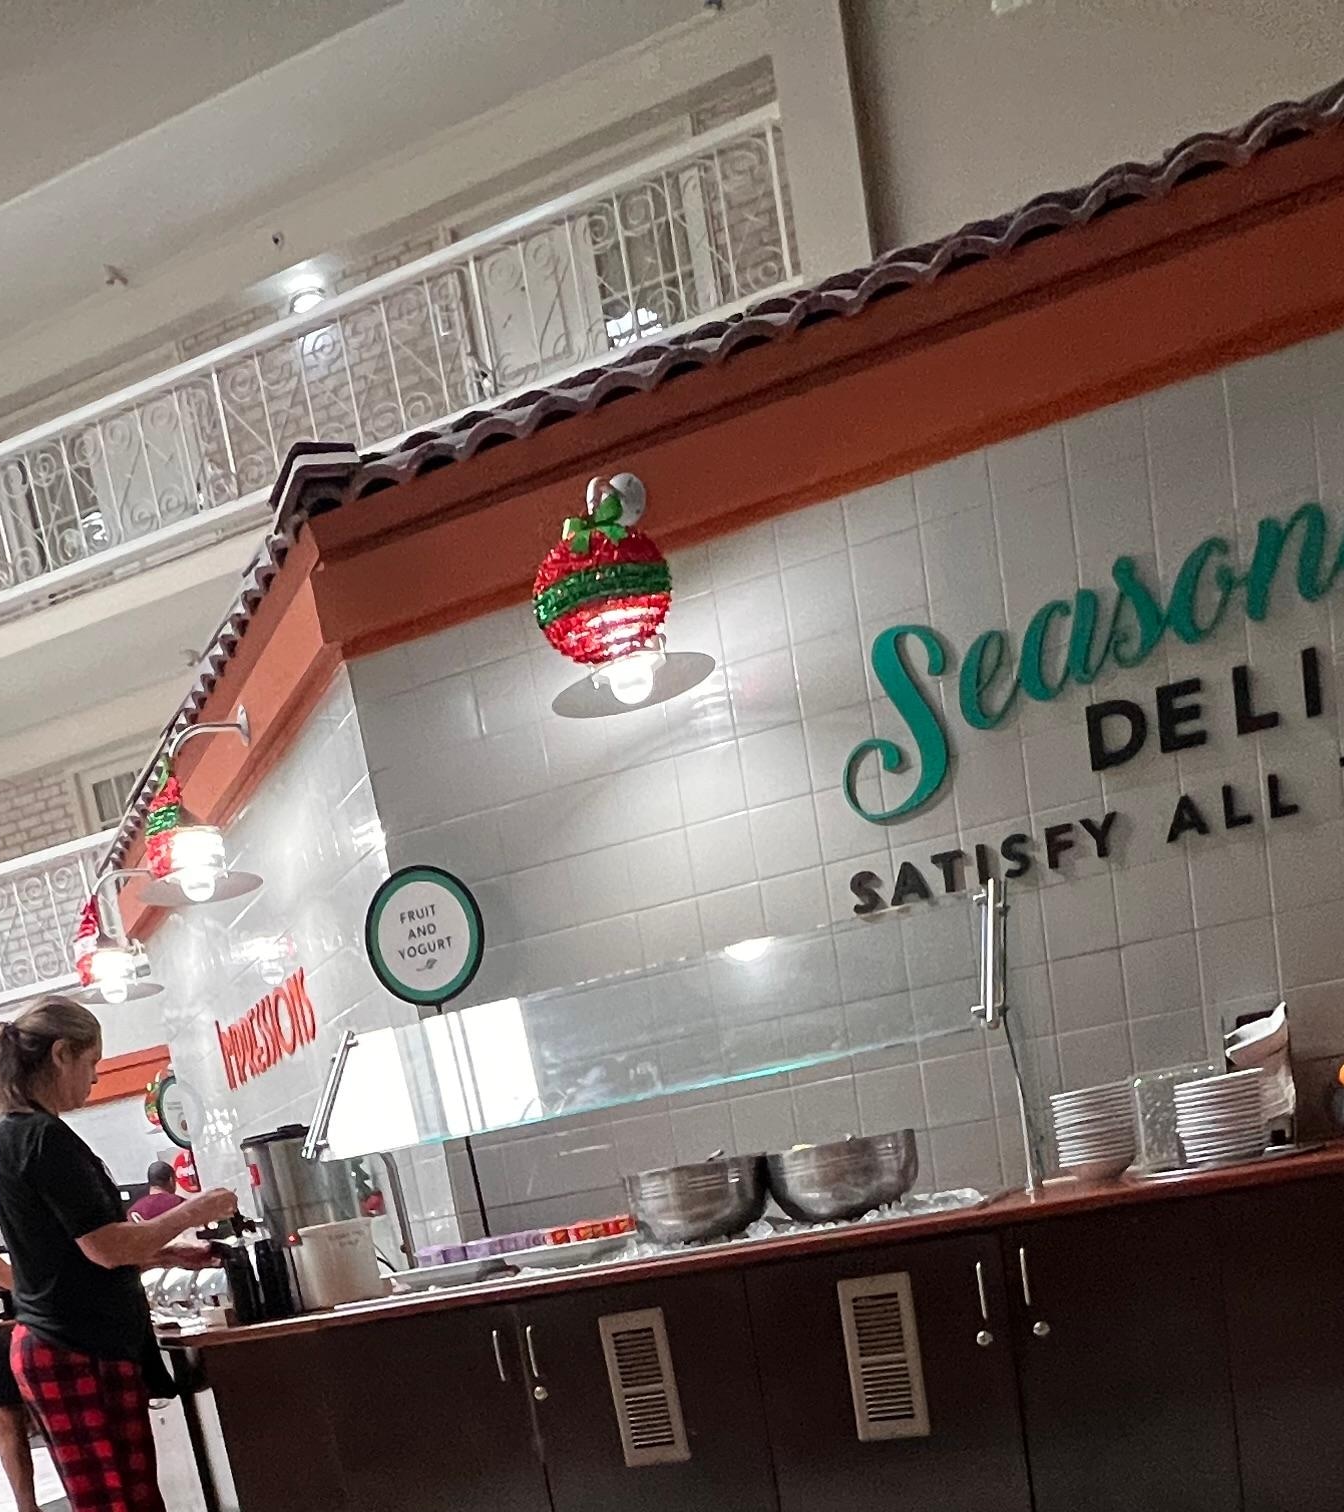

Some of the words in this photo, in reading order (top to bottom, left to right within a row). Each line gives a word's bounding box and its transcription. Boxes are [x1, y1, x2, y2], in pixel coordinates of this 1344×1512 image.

[850, 811, 1117, 914] SATISFY
[1166, 774, 1299, 843] ALL
[399, 904, 436, 924] FRUIT
[408, 923, 437, 940] AND
[398, 936, 453, 960] YOGURT
